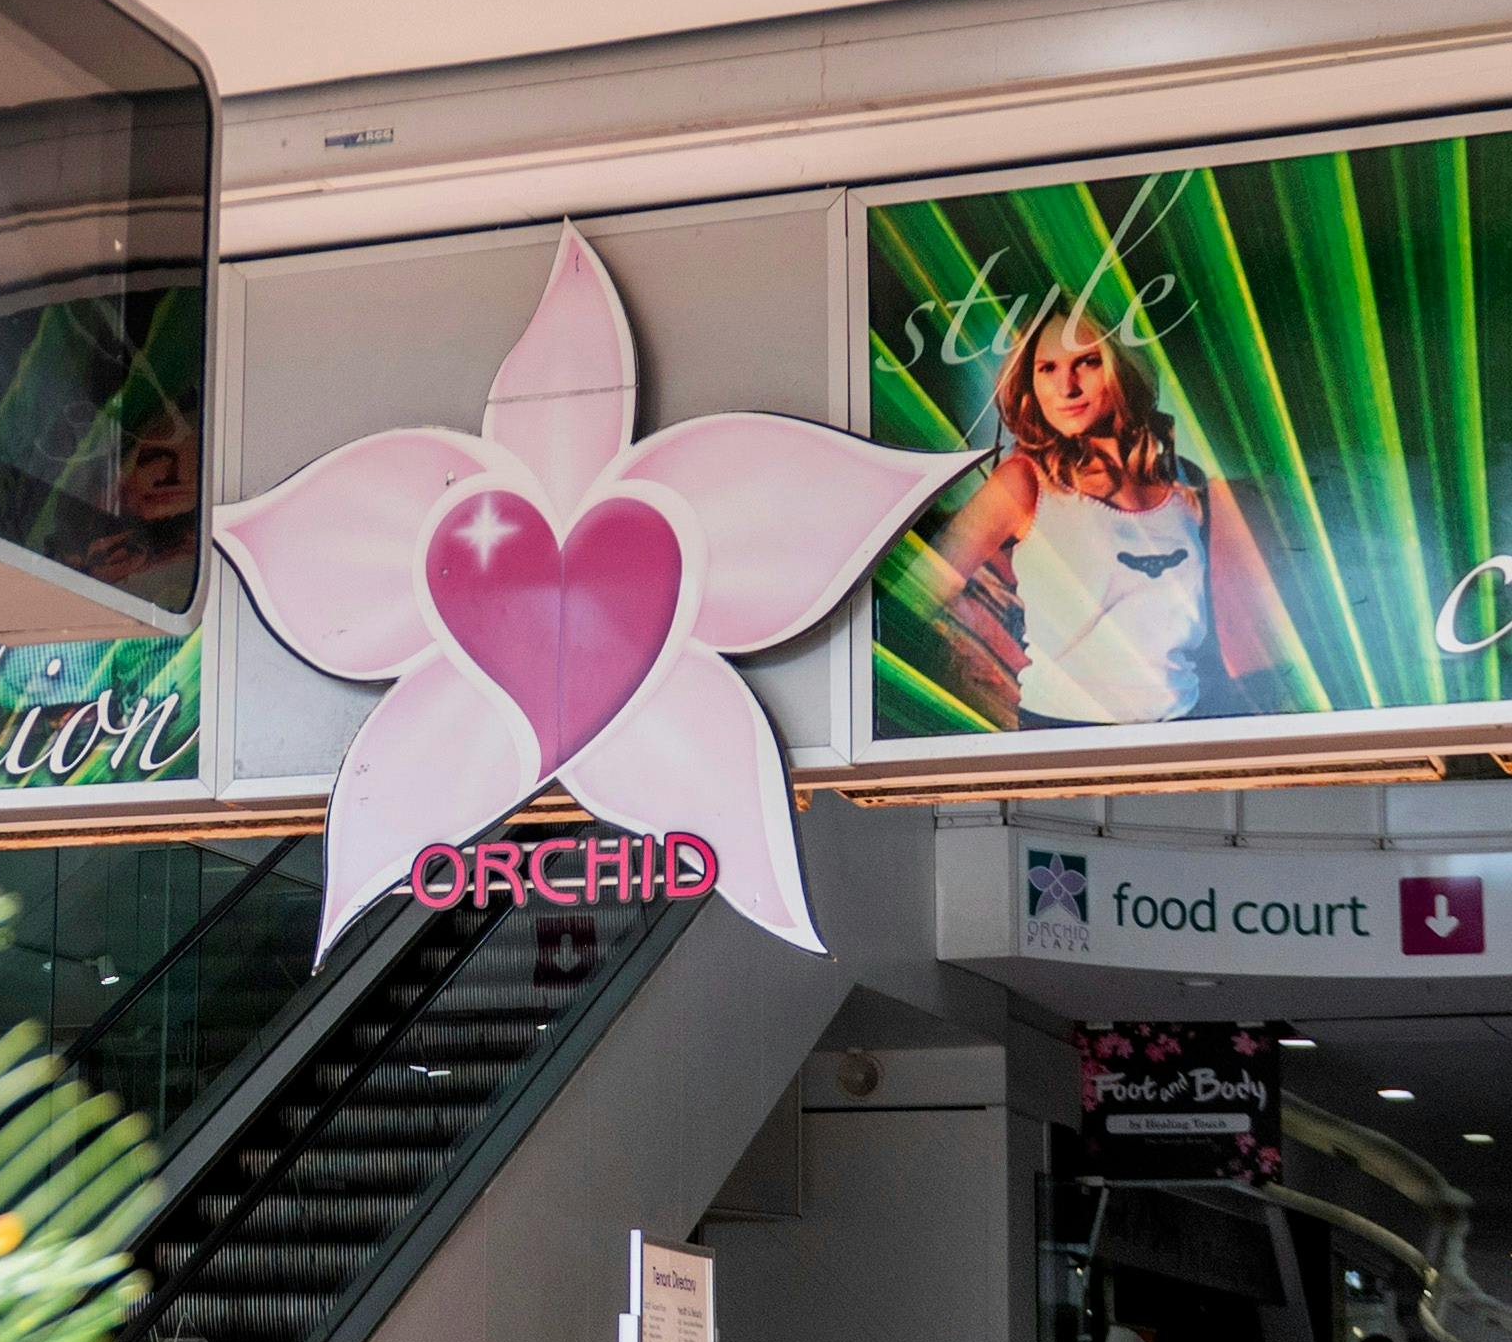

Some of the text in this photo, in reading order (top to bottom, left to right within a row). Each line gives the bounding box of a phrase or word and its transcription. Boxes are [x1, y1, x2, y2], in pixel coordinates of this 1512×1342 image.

[876, 168, 1199, 450] style
[410, 831, 719, 910] ORCHID
[1027, 919, 1090, 942] ORCHID
[1113, 881, 1370, 937] food court
[1027, 935, 1090, 953] PLAZA
[1090, 1071, 1158, 1103] Foot
[1188, 1067, 1267, 1111] Body
[672, 1269, 697, 1296] Directory
